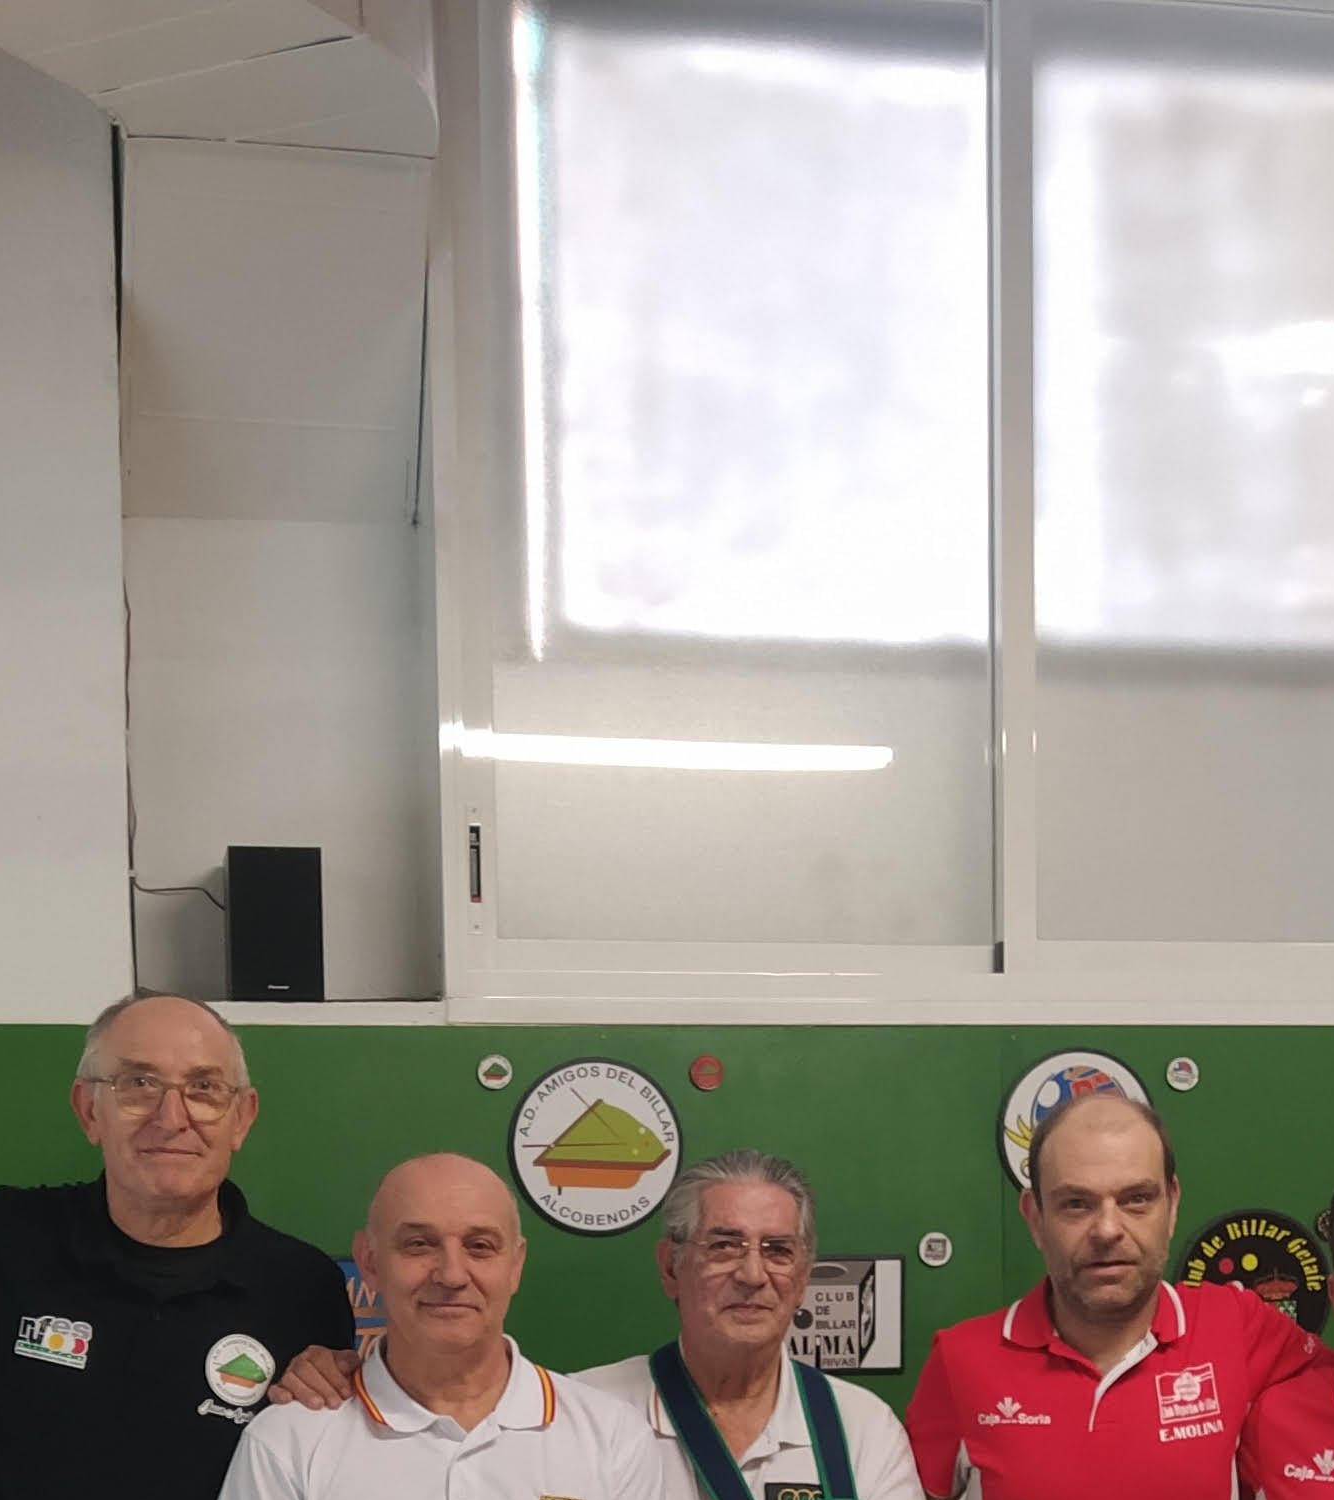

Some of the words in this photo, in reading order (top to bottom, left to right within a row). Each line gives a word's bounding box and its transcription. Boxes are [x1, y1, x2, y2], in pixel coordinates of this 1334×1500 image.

[519, 1105, 539, 1137] A.D.
[536, 1066, 601, 1101] AMIGOS
[606, 1067, 636, 1089] DEL
[639, 1086, 675, 1143] BILLAR
[540, 1193, 651, 1226] ALCOBENDAS
[1201, 1235, 1225, 1259] de
[1225, 1218, 1292, 1242] Billar
[814, 1291, 856, 1303] CLUB
[815, 1305, 831, 1316] DE
[815, 1319, 857, 1330] BILLAR
[1159, 1419, 1224, 1442] E.MOLINA
